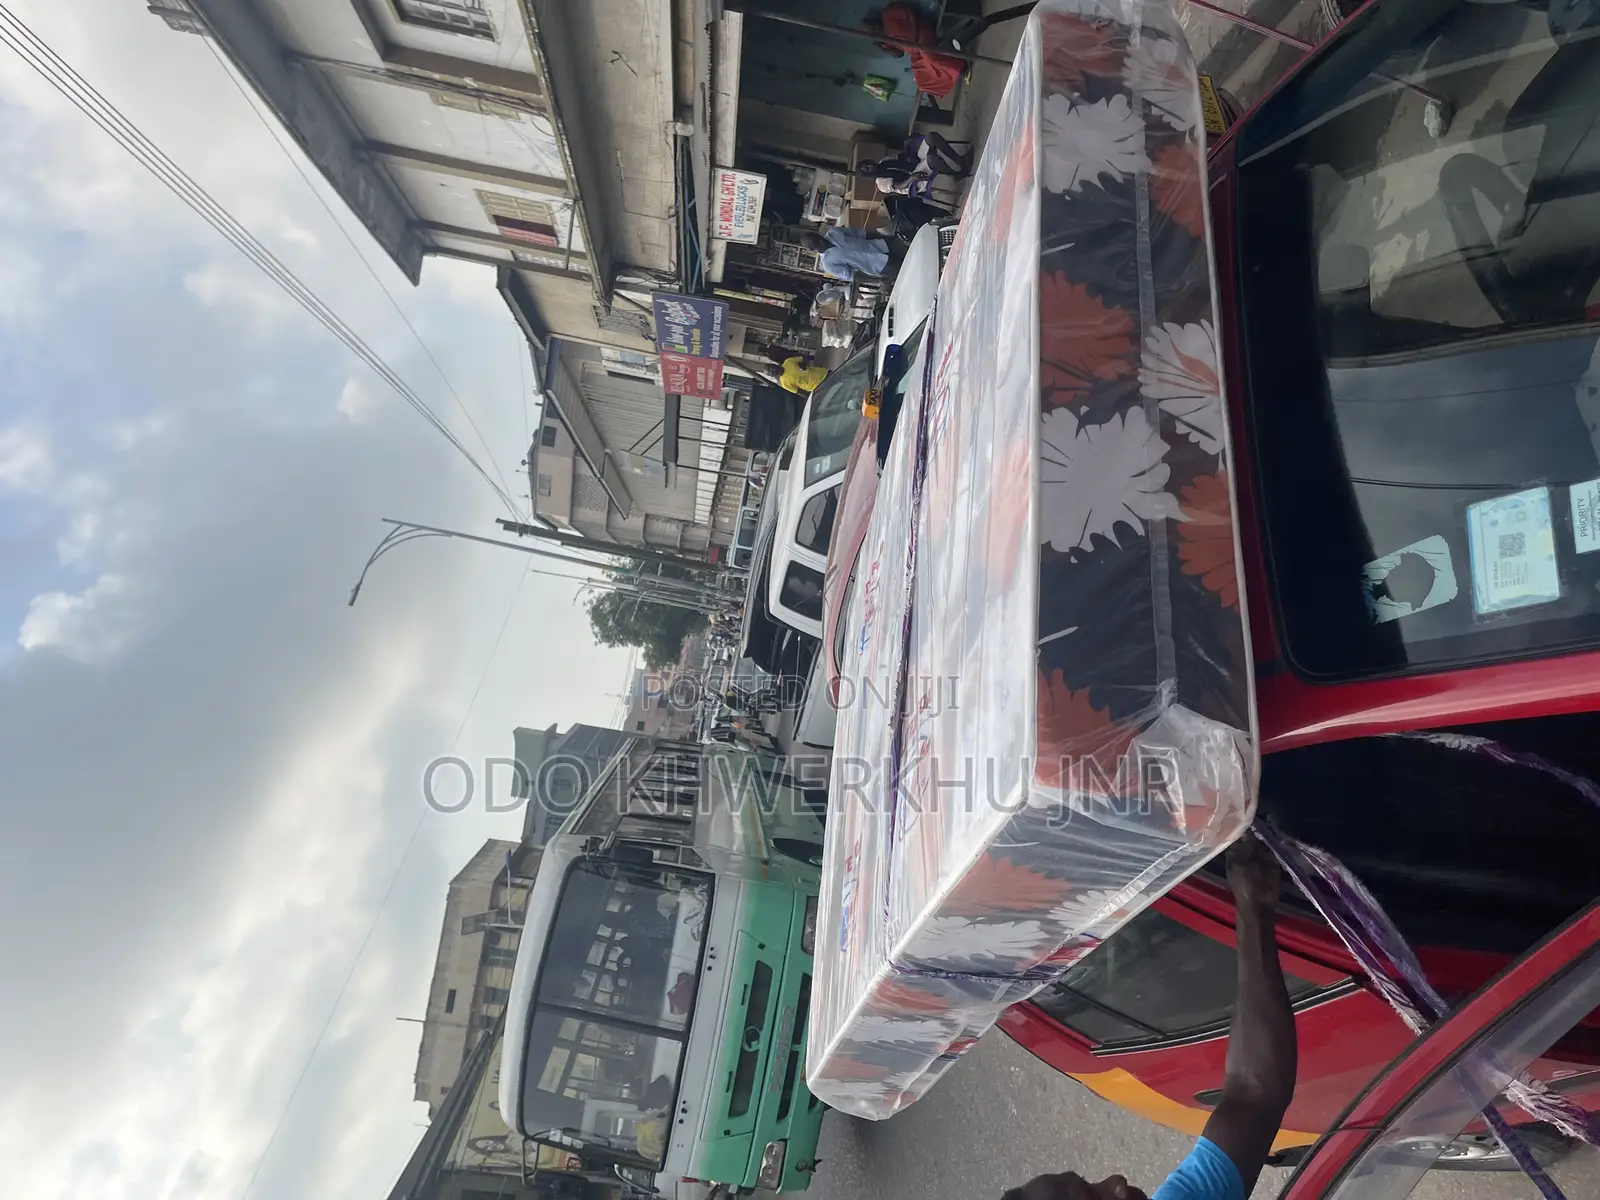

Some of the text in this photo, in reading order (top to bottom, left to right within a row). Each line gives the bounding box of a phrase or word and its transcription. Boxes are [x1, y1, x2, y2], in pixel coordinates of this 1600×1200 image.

[719, 197, 735, 222] MONDIAL
[711, 305, 722, 324] occasions
[690, 328, 700, 341] Durable
[712, 324, 723, 332] your
[690, 345, 702, 356] Strong
[709, 341, 720, 358] Disposables
[1577, 498, 1588, 538] PRIORITY
